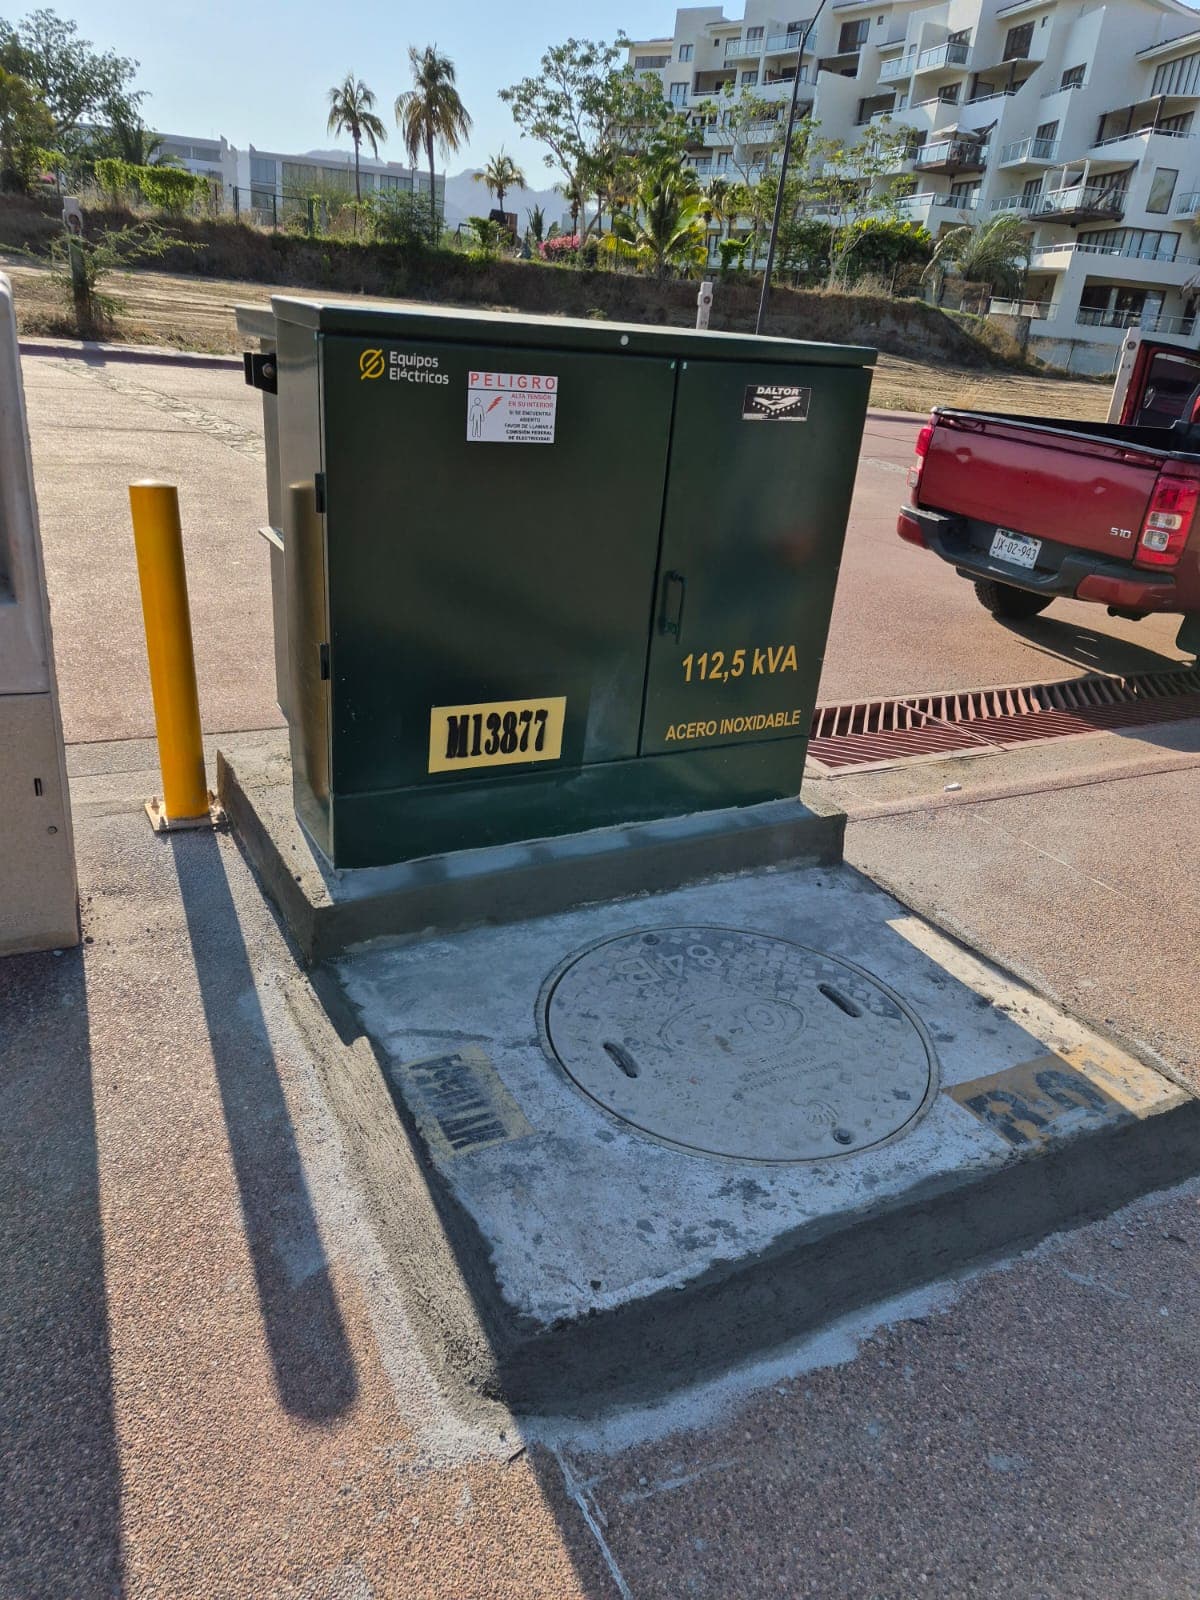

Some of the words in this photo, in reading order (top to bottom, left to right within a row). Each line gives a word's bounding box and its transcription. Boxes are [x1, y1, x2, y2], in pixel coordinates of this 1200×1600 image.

[389, 351, 439, 369] Equipos
[389, 367, 449, 385] Eléctricos
[470, 373, 556, 390] PELIGRO
[756, 386, 799, 395] DALTOR
[1110, 527, 1132, 539] S10
[993, 536, 1037, 561] JX-02-943
[682, 649, 746, 683] 112,5
[751, 645, 798, 676] kVA
[445, 709, 549, 759] M13877
[665, 720, 718, 741] ACERO
[719, 709, 802, 735] INOXIDABLE
